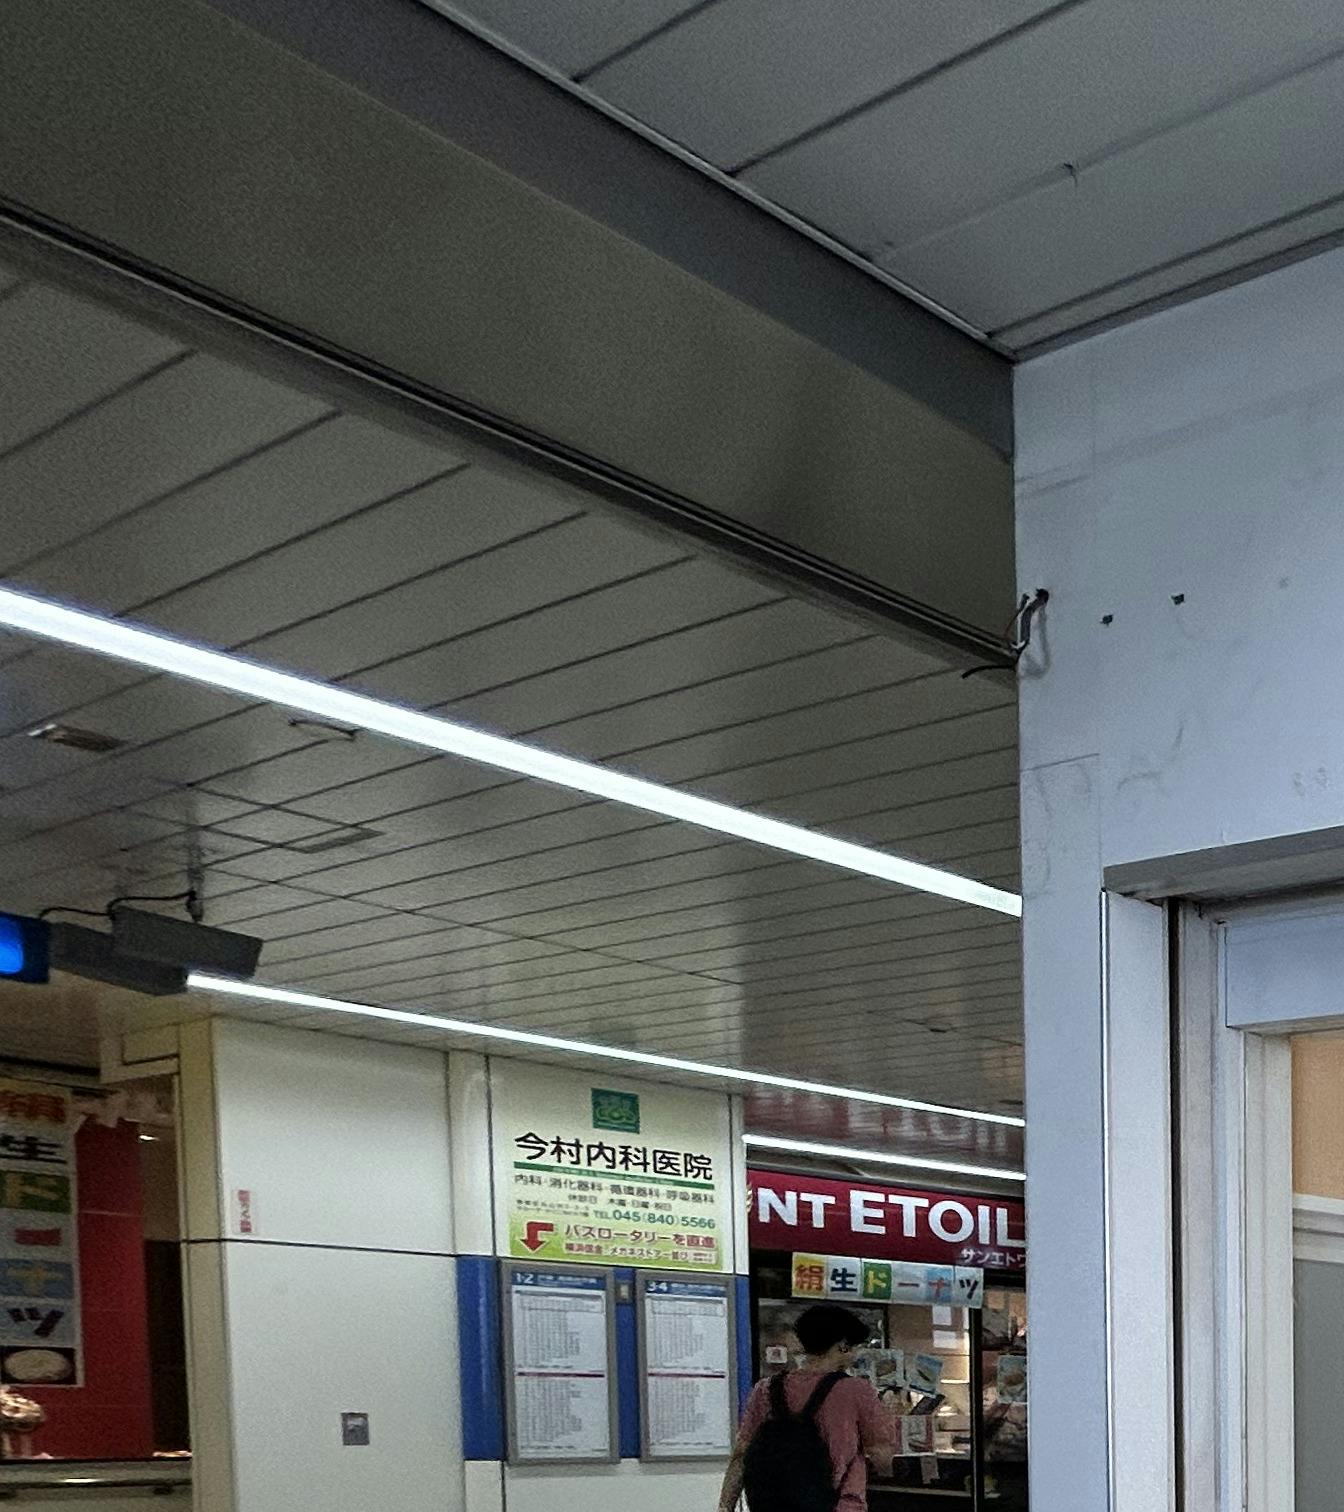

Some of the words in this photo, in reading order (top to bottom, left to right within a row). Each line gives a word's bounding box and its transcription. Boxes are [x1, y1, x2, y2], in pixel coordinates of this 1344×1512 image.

[514, 1131, 713, 1180] 今村内科医院
[757, 1187, 836, 1229] NT
[849, 1189, 1026, 1247] ETOIL
